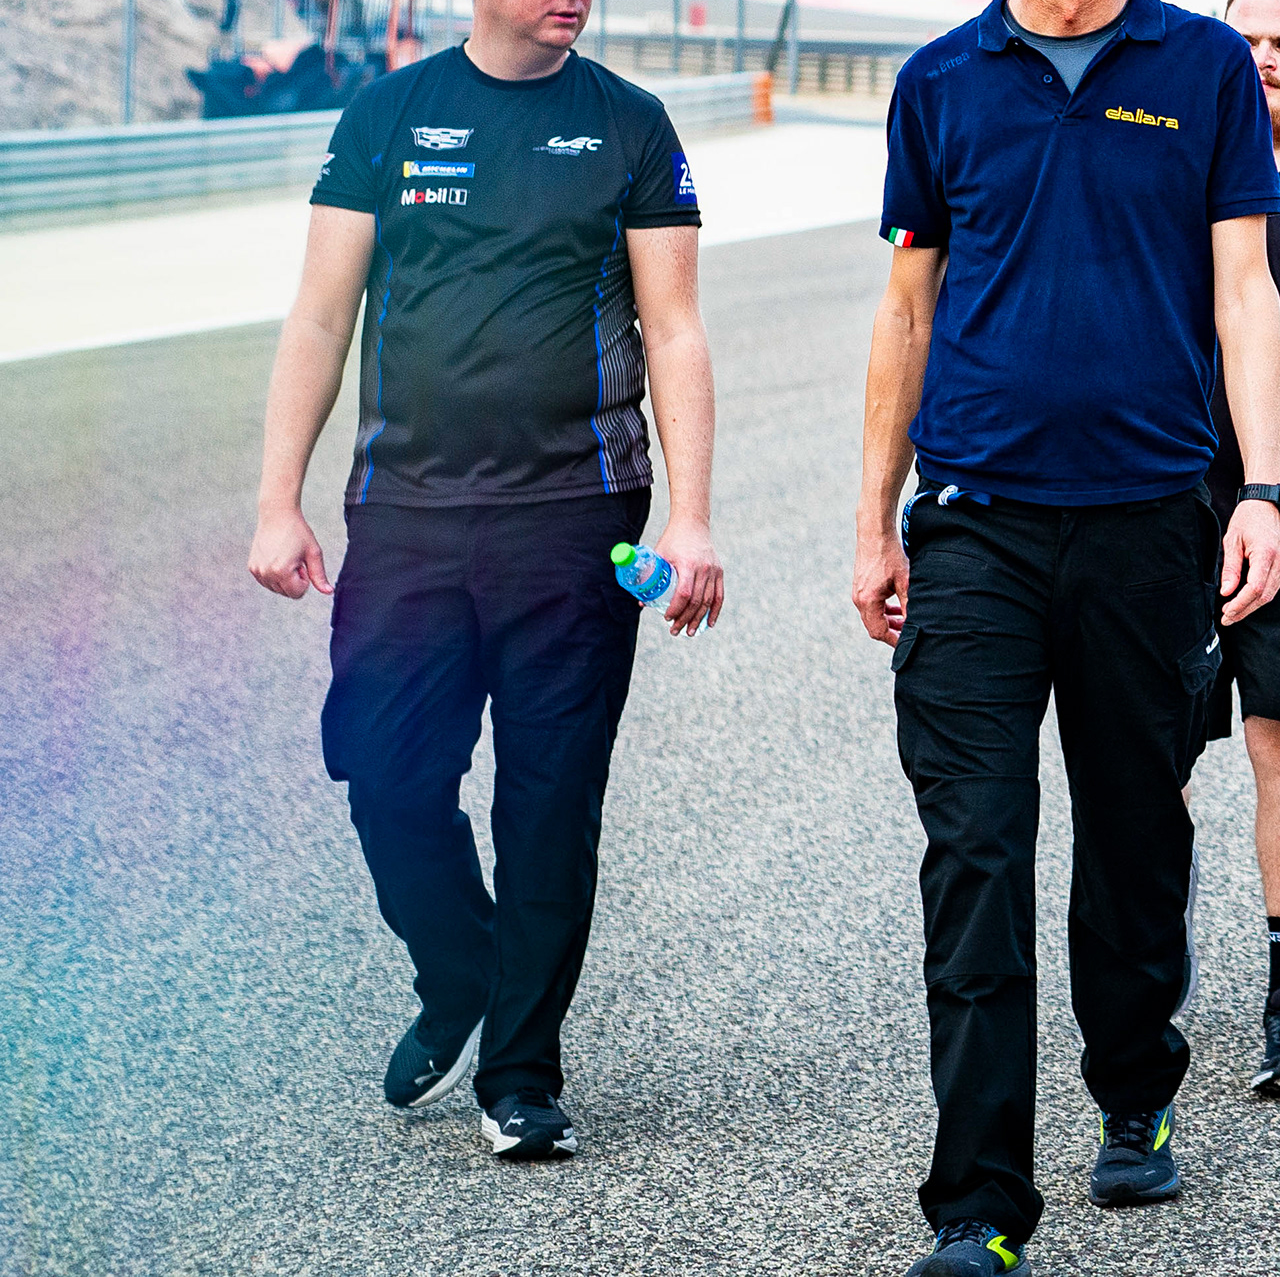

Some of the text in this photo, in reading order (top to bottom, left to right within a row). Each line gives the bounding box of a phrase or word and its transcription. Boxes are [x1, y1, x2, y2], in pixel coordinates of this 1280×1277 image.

[1105, 106, 1179, 130] dallara
[548, 136, 602, 151] WEC
[401, 188, 447, 206] Mobil
